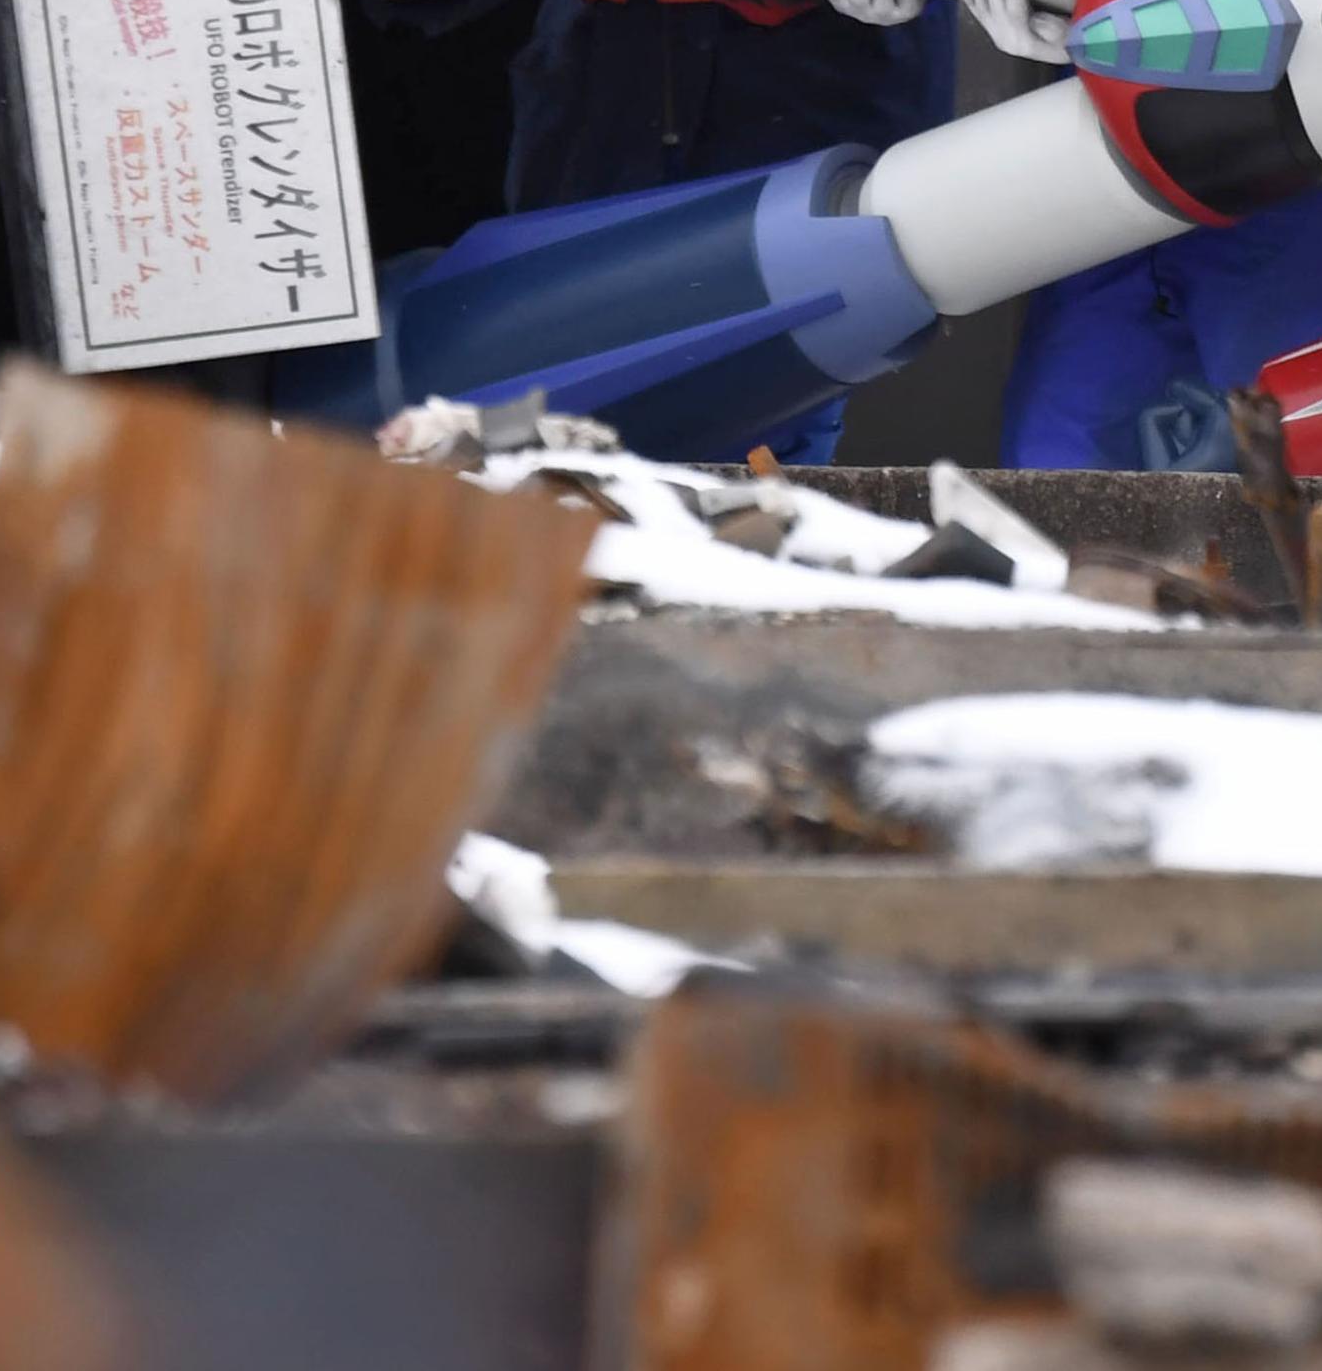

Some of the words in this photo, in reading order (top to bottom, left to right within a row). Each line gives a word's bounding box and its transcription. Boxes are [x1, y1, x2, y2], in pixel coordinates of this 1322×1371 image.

[202, 17, 224, 58] UFO
[207, 62, 233, 128] ROBOT
[217, 134, 246, 226] Grendizer
